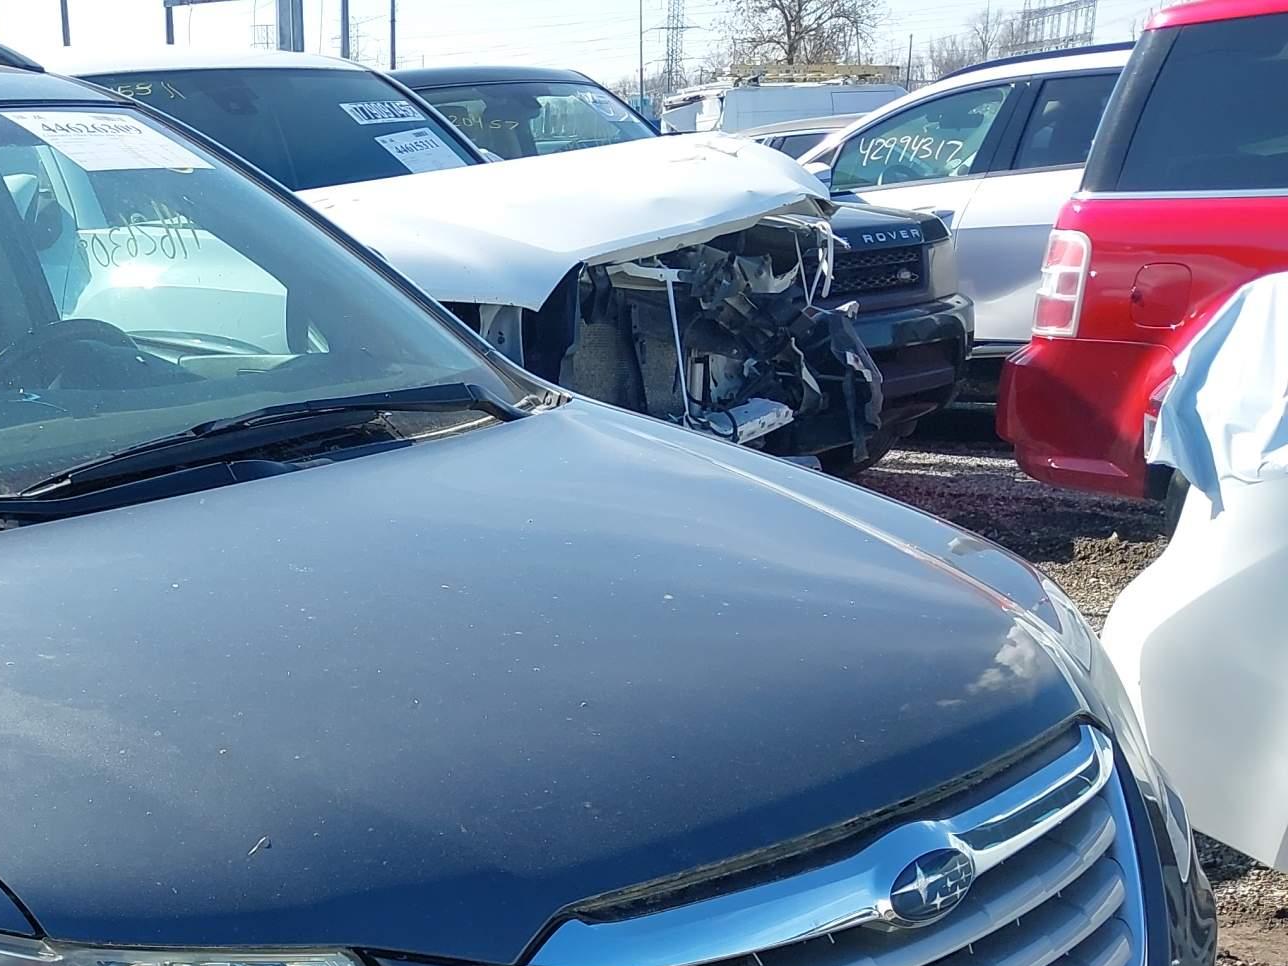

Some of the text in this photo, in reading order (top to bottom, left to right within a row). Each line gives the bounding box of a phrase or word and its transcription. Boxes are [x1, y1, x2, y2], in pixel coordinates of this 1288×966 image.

[41, 122, 143, 135] 44626309
[395, 139, 440, 155] 44615311
[859, 135, 963, 166] 42994317
[862, 229, 920, 244] ROVER
